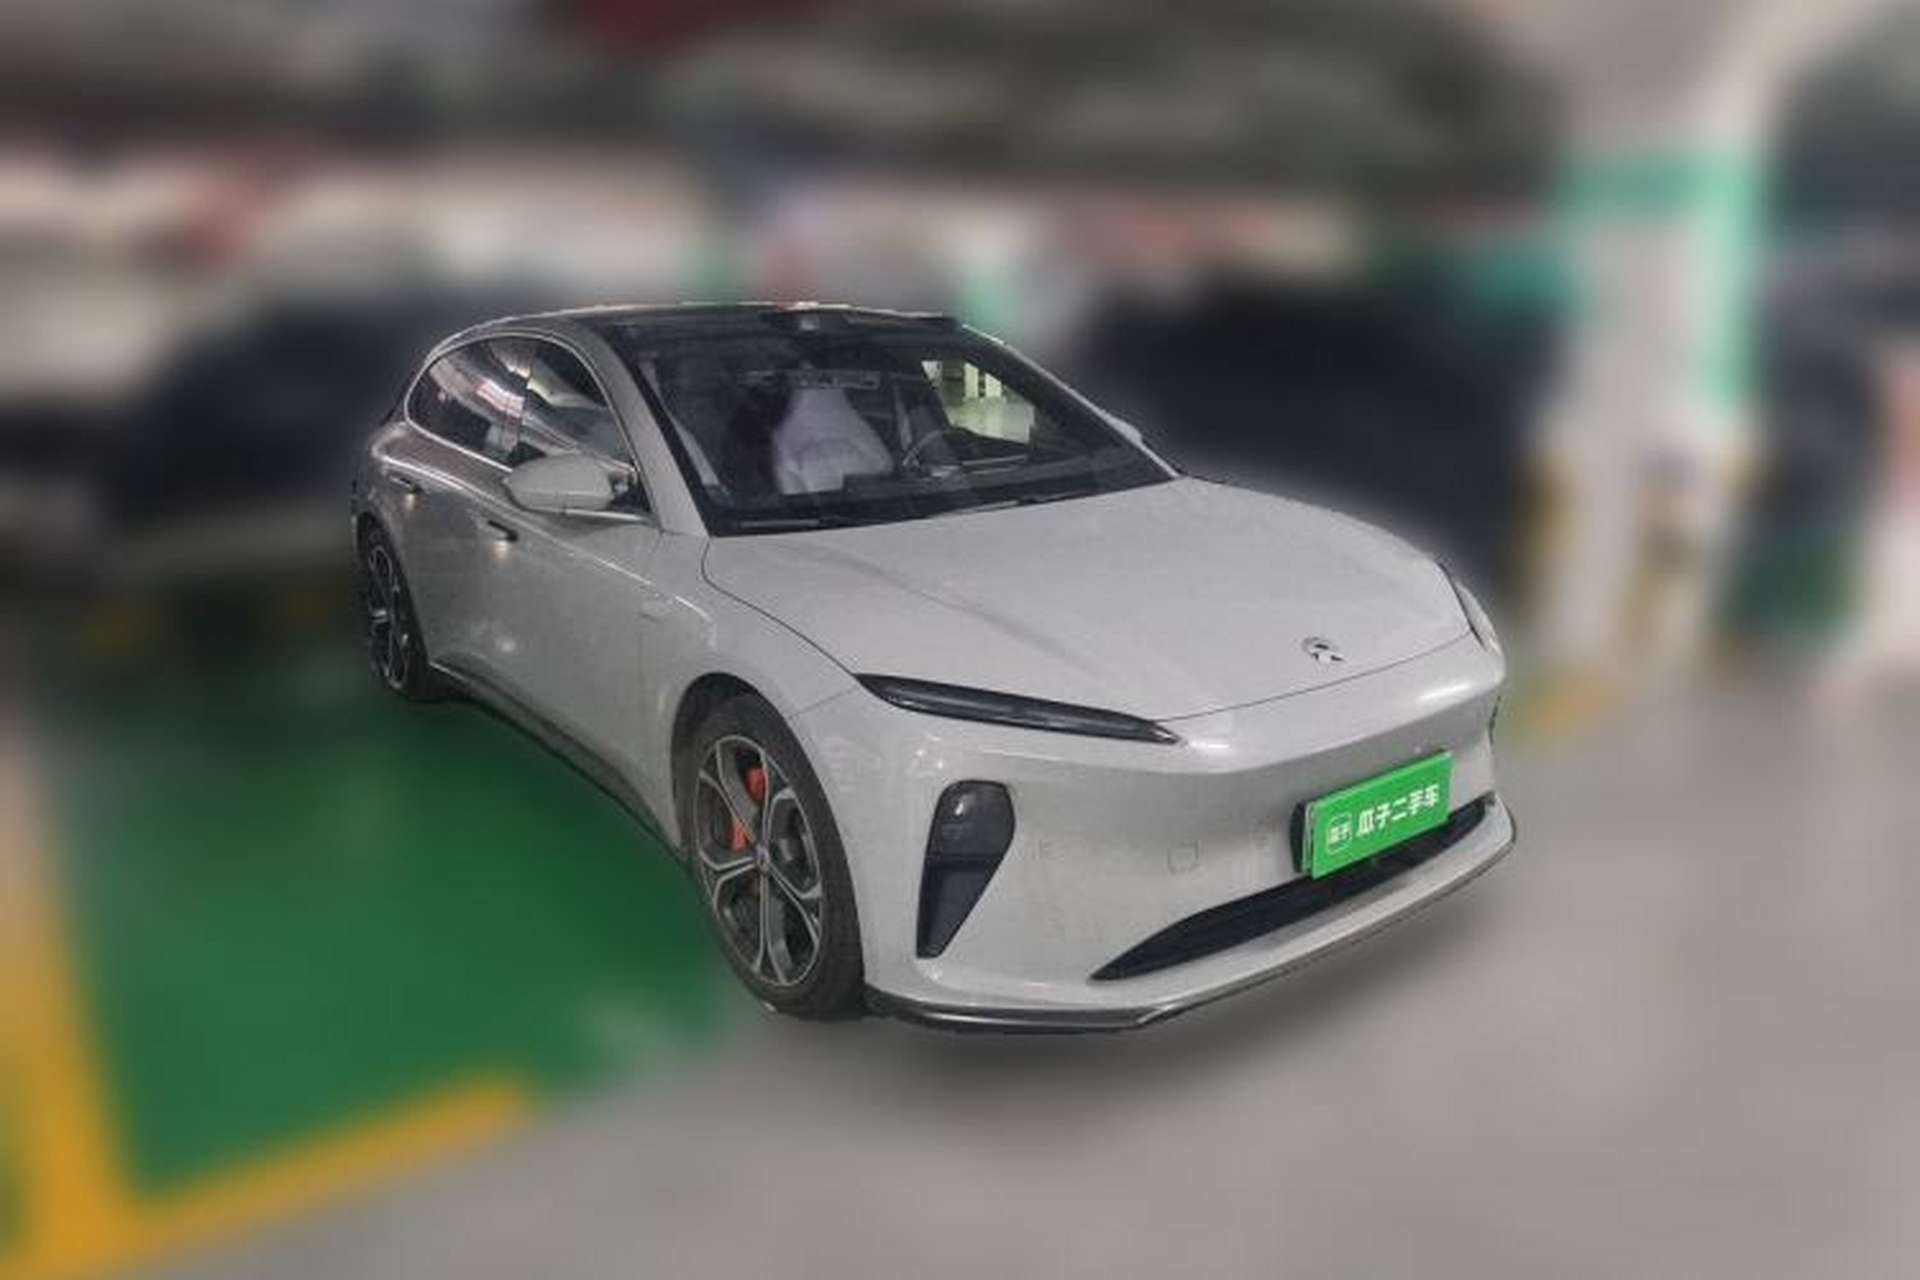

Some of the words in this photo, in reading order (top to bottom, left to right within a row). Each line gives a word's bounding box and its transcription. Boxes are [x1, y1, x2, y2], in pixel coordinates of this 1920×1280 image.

[1356, 784, 1440, 837] 瓜子二手车
